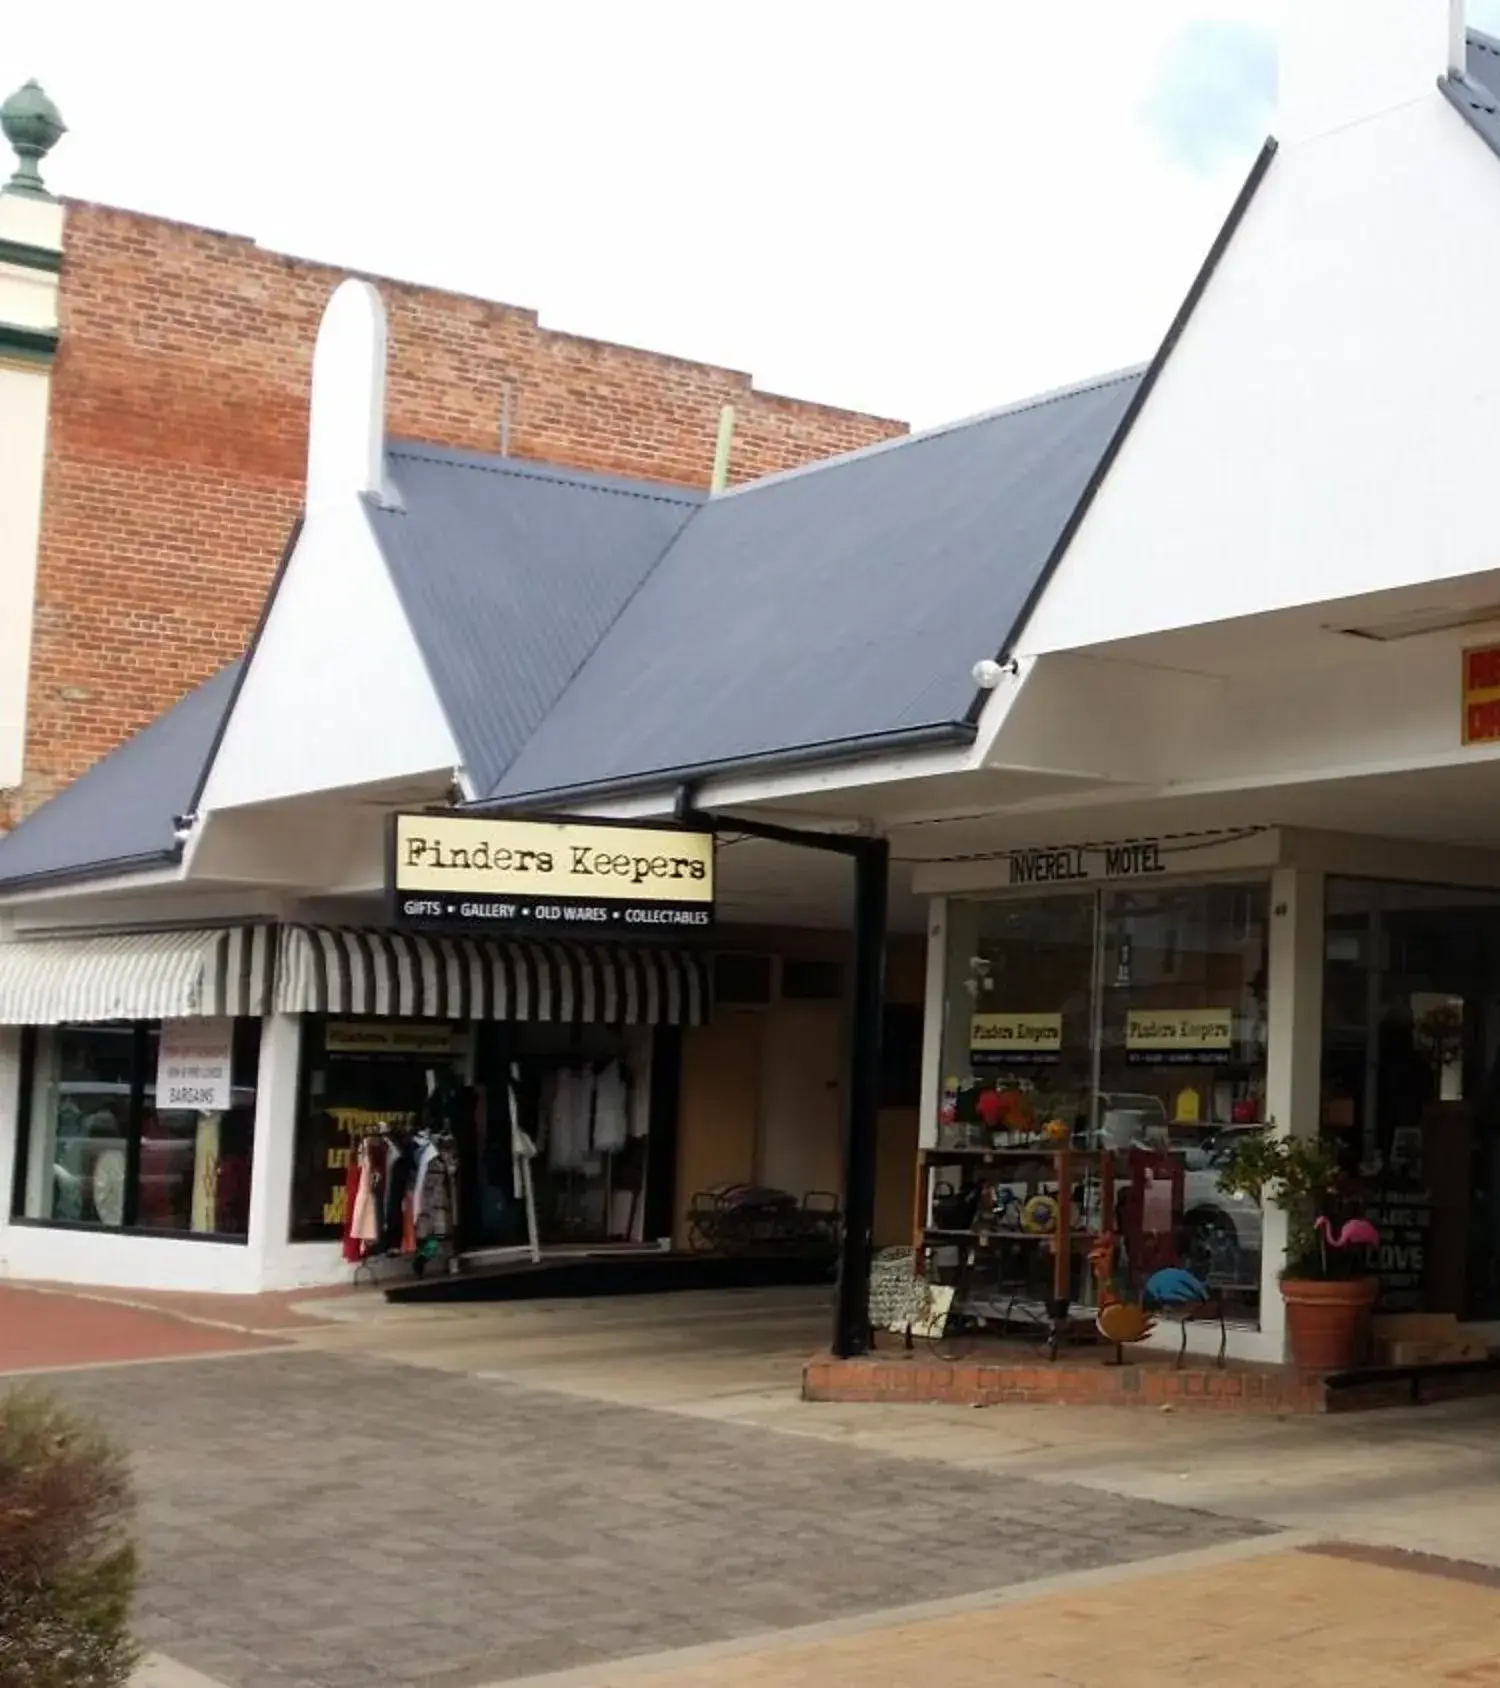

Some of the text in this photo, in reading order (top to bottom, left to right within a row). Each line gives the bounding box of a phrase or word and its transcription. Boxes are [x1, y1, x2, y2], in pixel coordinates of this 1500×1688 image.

[405, 837, 706, 884] Finders Keepers
[1009, 843, 1166, 884] INVERELL MOTEL
[404, 902, 709, 924] GIFTS GALLERY OLD WARES COLLECTABLES
